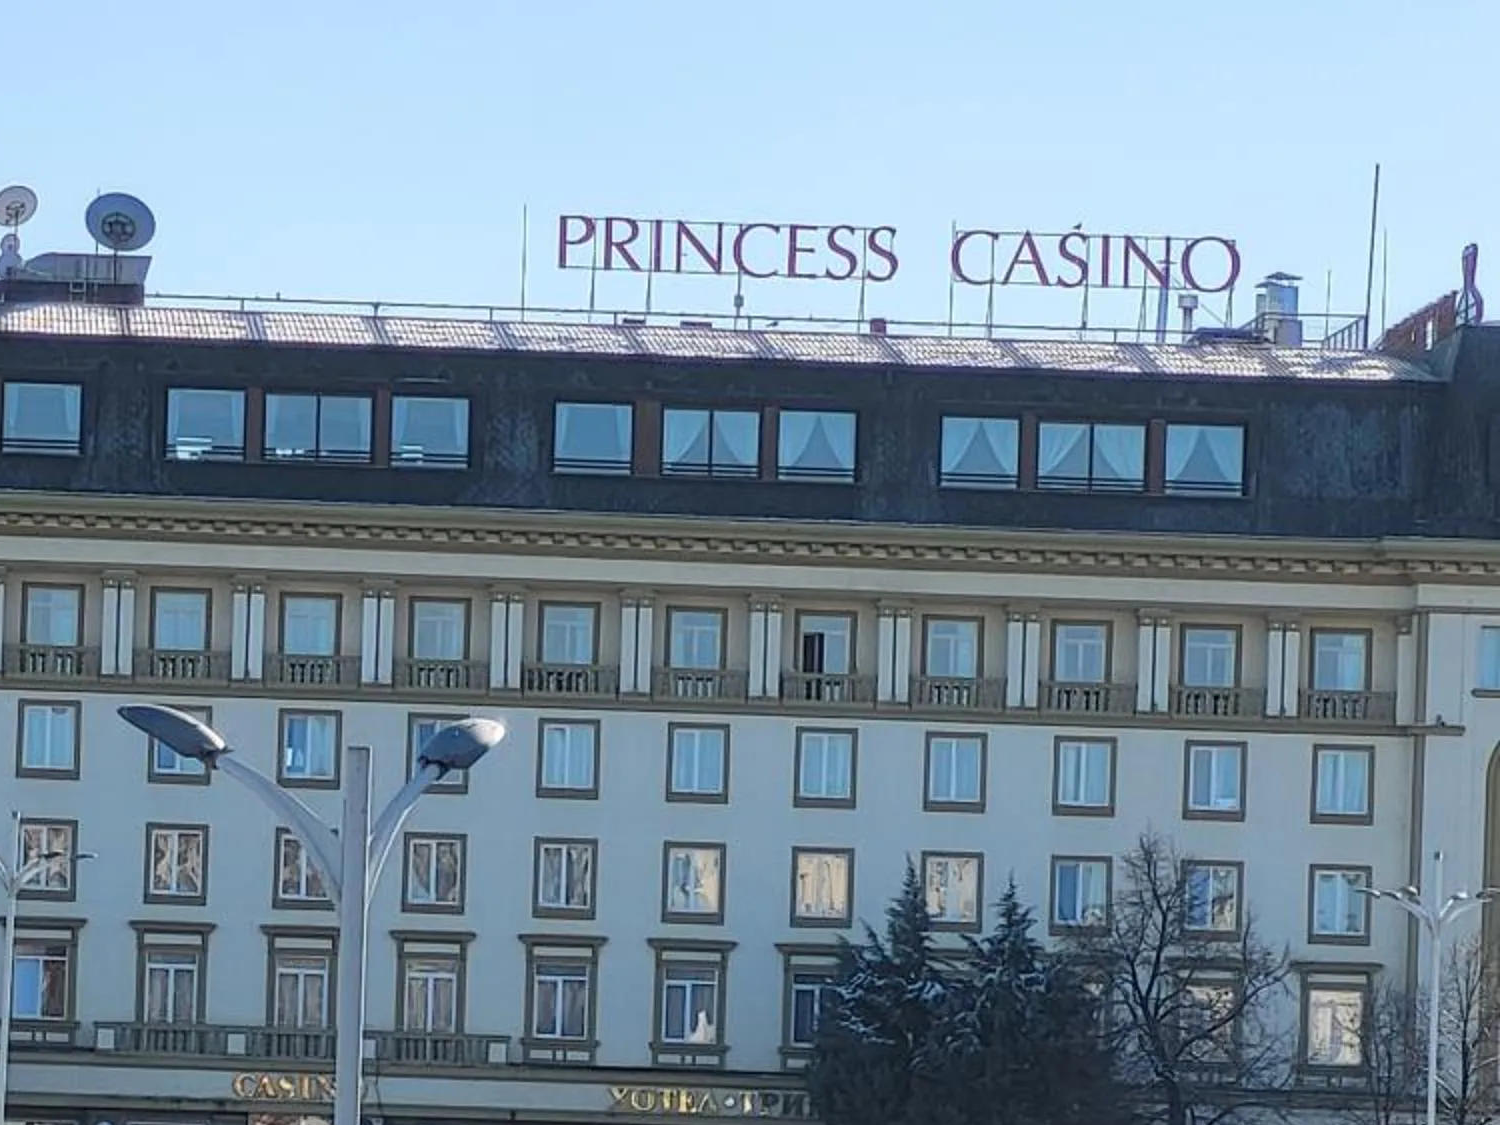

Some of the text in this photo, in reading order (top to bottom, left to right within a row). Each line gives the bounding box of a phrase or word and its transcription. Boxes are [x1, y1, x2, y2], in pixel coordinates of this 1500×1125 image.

[558, 214, 1242, 293] PRINCESS CASINO
[232, 1072, 368, 1100] CASIN
